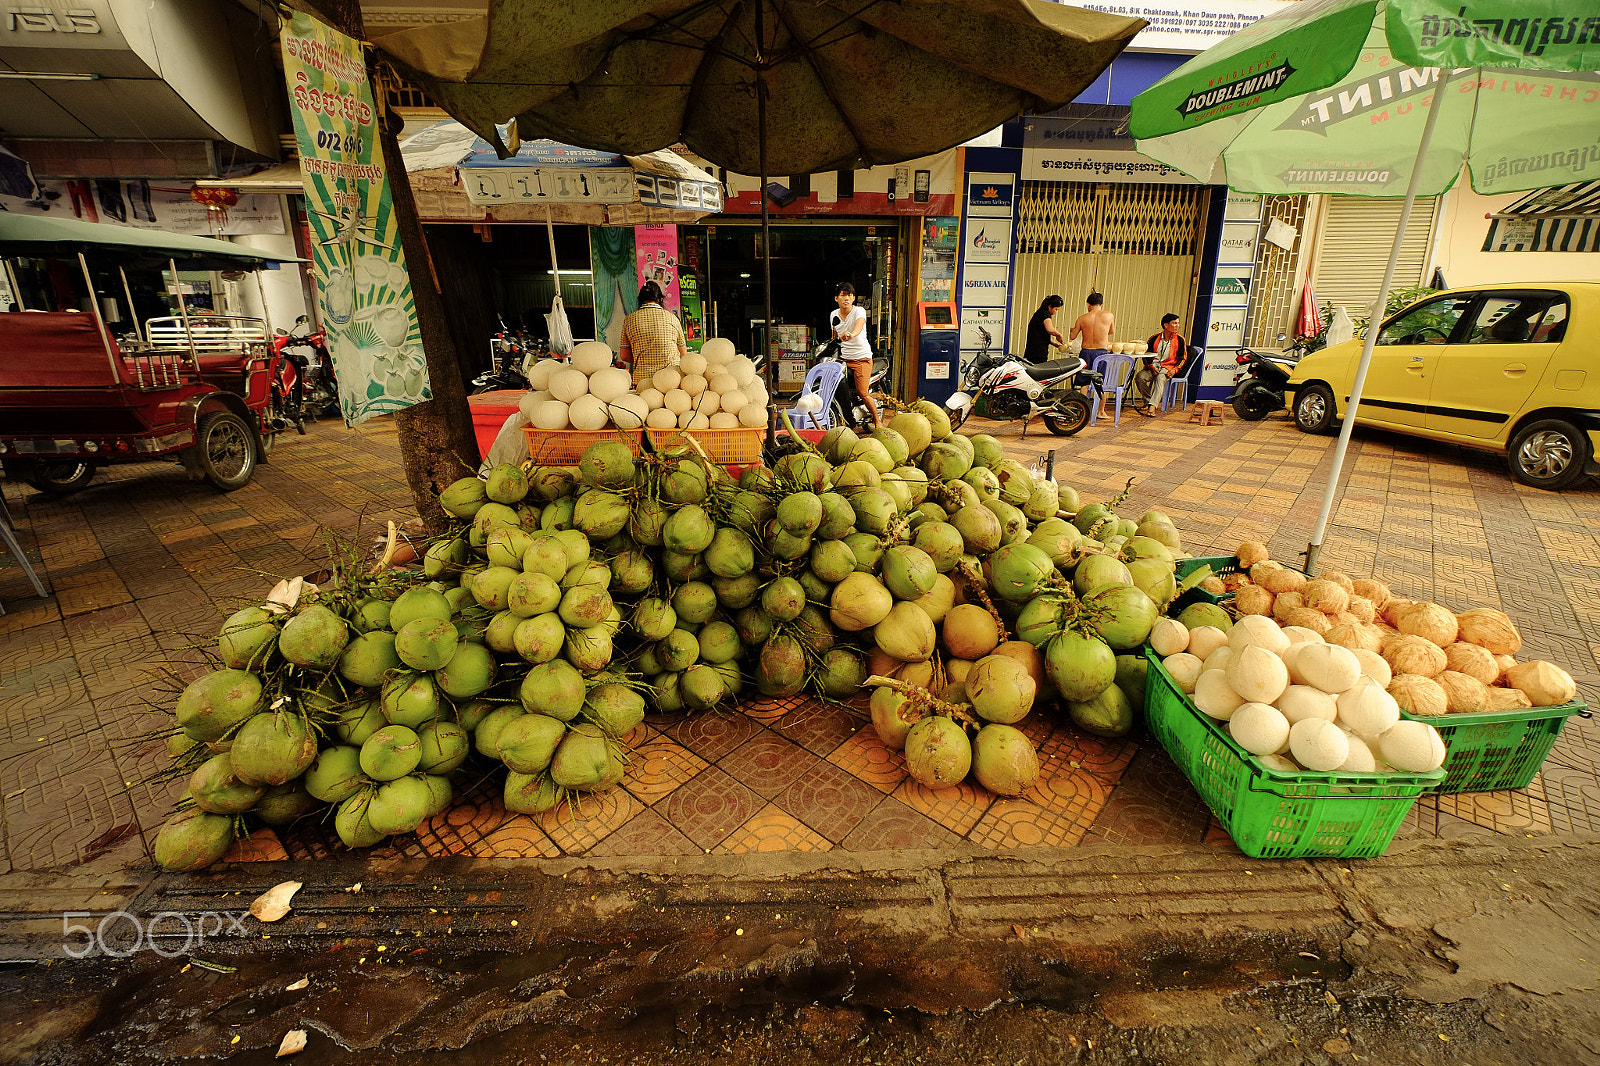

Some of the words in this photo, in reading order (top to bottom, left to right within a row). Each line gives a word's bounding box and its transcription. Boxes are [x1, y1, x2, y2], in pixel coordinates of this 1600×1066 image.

[6, 7, 101, 34] ASUS
[1183, 10, 1200, 18] Khan
[1186, 66, 1286, 113] DOUBLEMINT
[1195, 102, 1233, 121] CHEWING
[1238, 96, 1260, 108] GUM
[318, 130, 341, 152] 012
[964, 280, 992, 288] KOREAN
[1221, 322, 1242, 331] THAI
